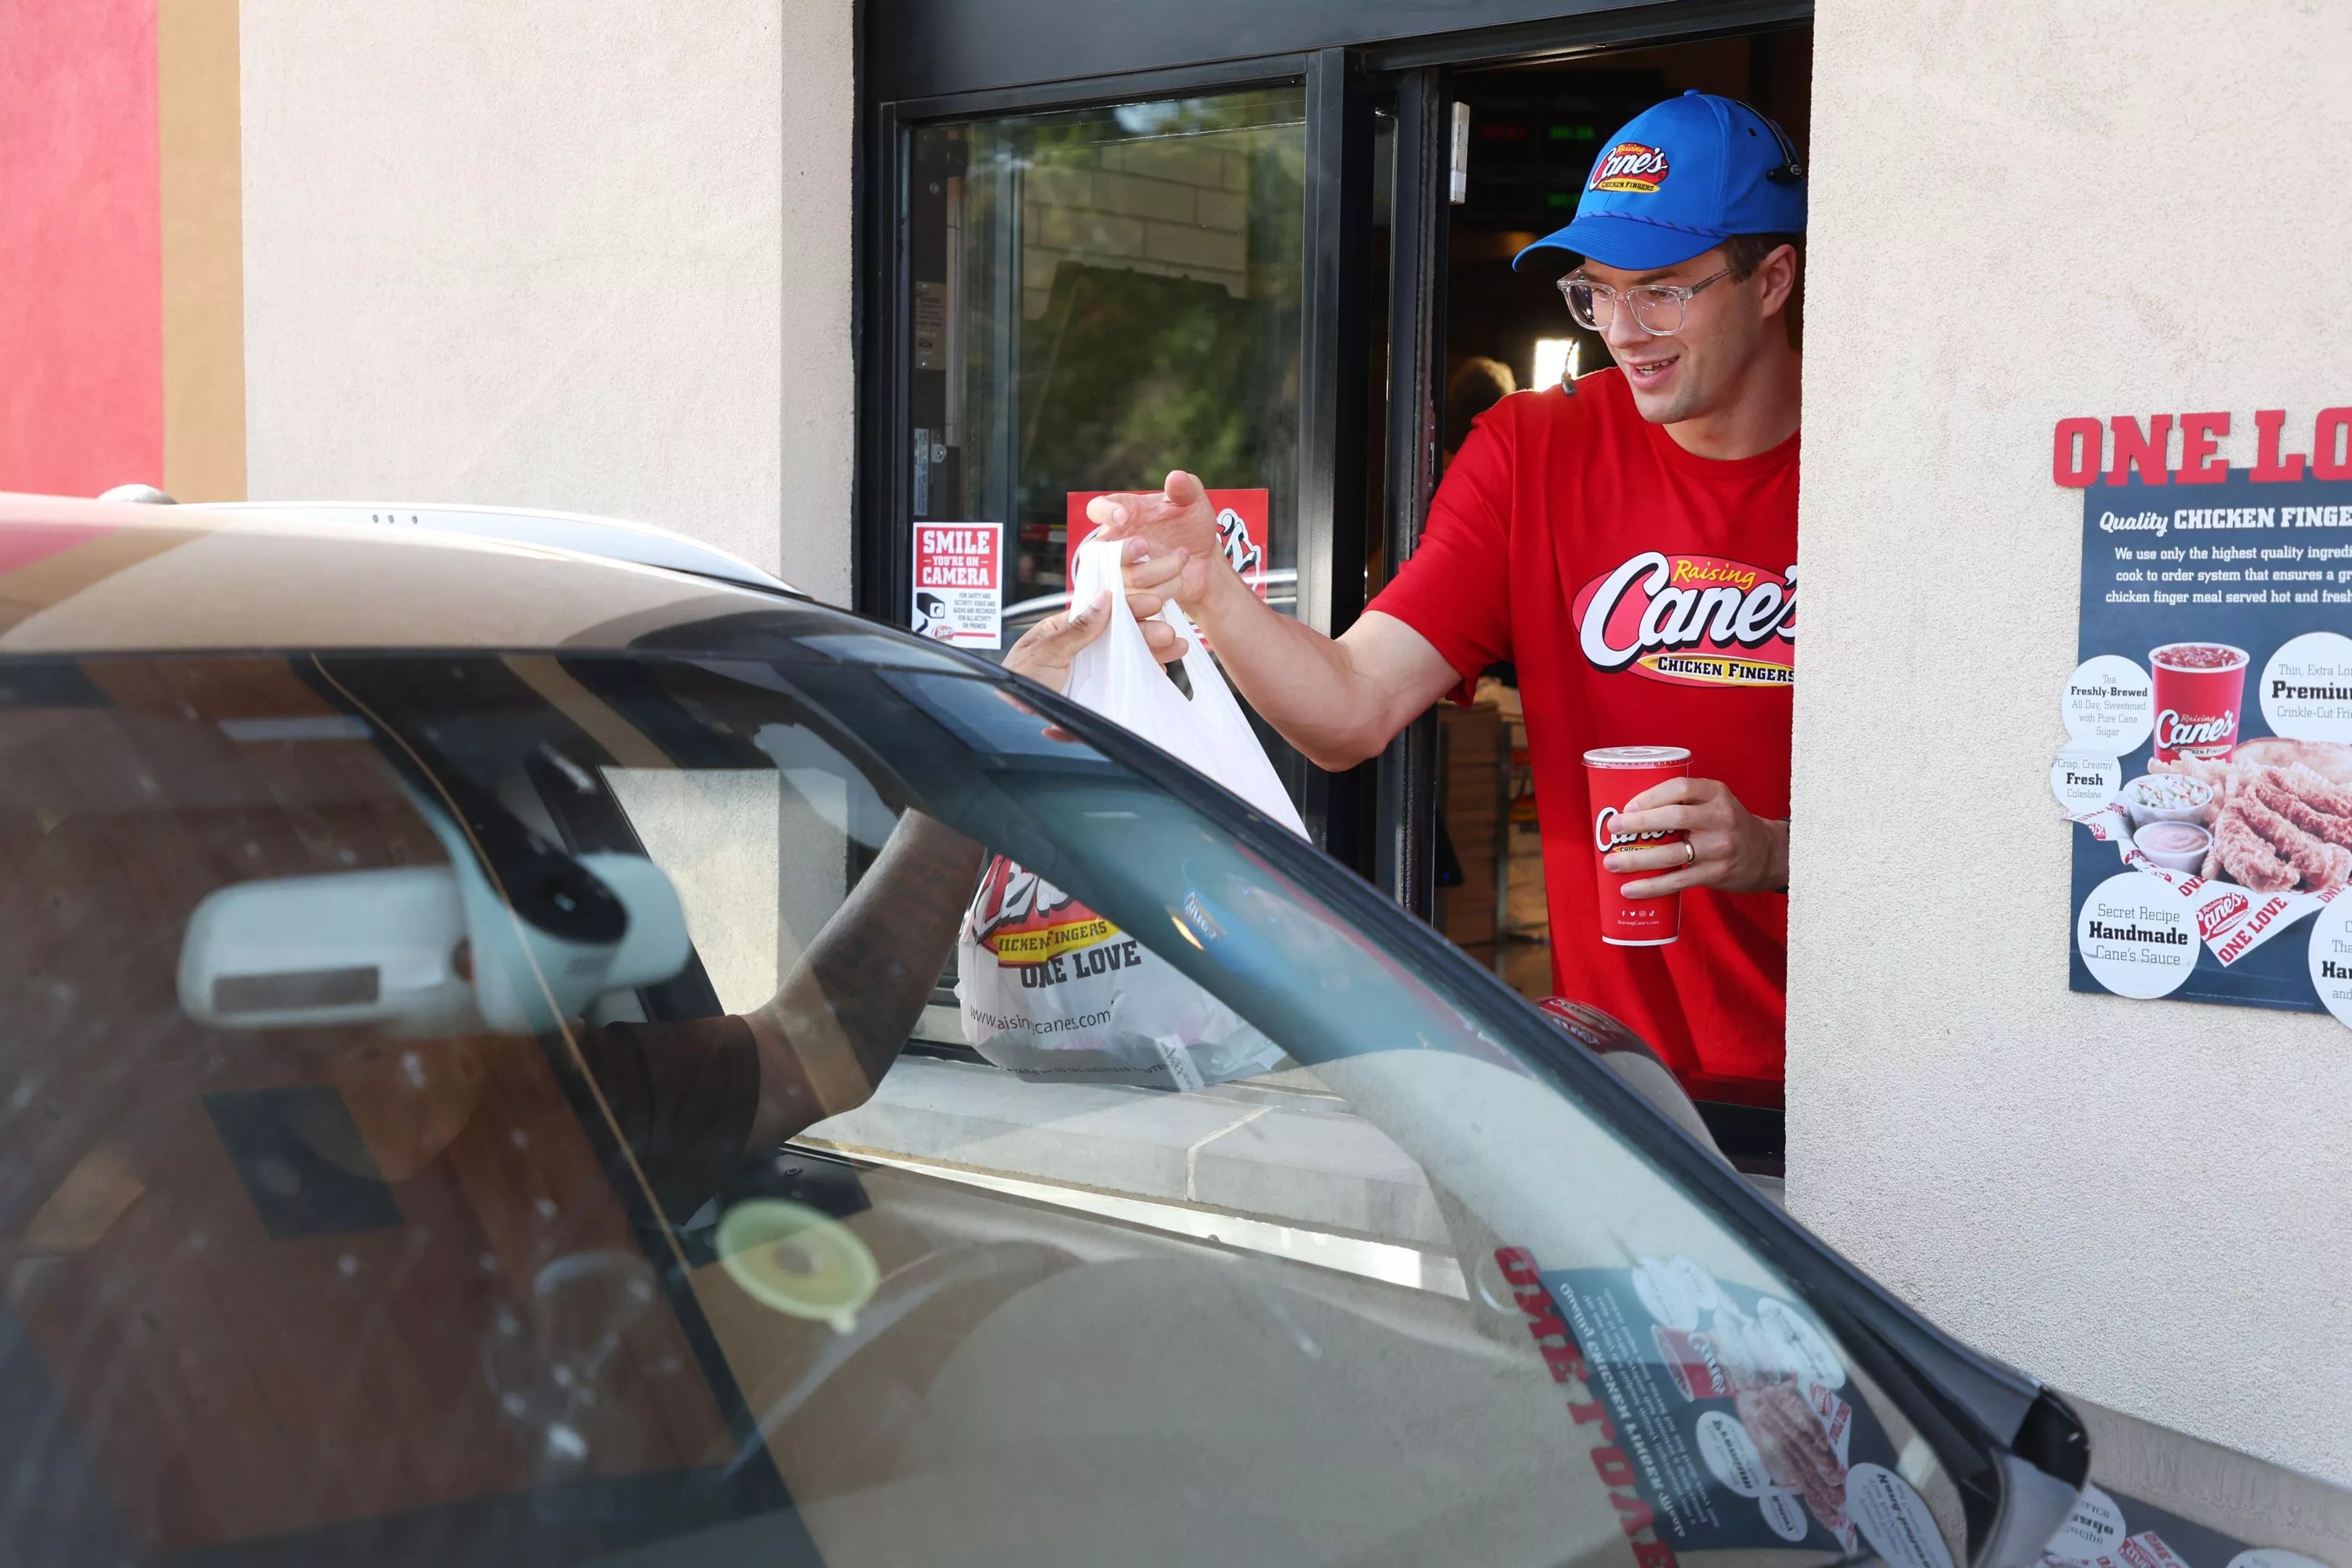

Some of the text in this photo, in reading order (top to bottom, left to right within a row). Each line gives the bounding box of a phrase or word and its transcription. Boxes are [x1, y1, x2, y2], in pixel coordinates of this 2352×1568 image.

[1617, 144, 1645, 154] Raising
[1589, 147, 1668, 190] Cane's
[1625, 181, 1654, 191] FINGERS
[2053, 408, 2352, 488] ONE LO
[2099, 505, 2352, 537] Quality CHICKEN FINGE
[923, 530, 990, 555] SMILE
[933, 555, 979, 567] YOU'RE ON
[2115, 544, 2352, 563] We use only the highest quality ingredi
[923, 567, 989, 586] CAMERA
[1673, 560, 1756, 589] Raising
[2115, 569, 2144, 581] cook
[2147, 570, 2158, 581] to
[2161, 568, 2194, 581] order
[2197, 570, 2242, 584] system
[2245, 568, 2269, 581] that
[2272, 570, 2323, 581] ensures
[2326, 571, 2335, 581] a
[2105, 591, 2150, 603] chicken
[2153, 590, 2189, 605] finger
[2192, 590, 2222, 603] meal
[2226, 589, 2267, 603] served
[2270, 590, 2291, 603] hot
[2295, 589, 2318, 603] and
[1657, 656, 1723, 676] CHICKEN
[2279, 663, 2352, 677] Thin, Extra Lo
[2102, 674, 2116, 684] Tea
[2070, 686, 2148, 699] Freshly-Brewed
[2272, 679, 2352, 699] Premiu
[2071, 700, 2147, 711] All Day, Sweetened
[2277, 706, 2333, 718] Crinkle-Cut
[2078, 714, 2138, 723] with Pure Cane
[2181, 714, 2216, 724] Raising
[2096, 727, 2120, 738] Sugar
[2156, 709, 2236, 749] Cane's
[2058, 759, 2113, 771] Crisp, Creamy
[2066, 772, 2104, 785] Fresh
[2067, 788, 2102, 799] Coleslaw
[2098, 903, 2180, 923] Secret Recipe
[1048, 920, 1107, 945] FINGERS
[2088, 920, 2188, 945] Handmade
[2218, 897, 2289, 963] ONE LOVE
[1072, 940, 1142, 979] LOVE
[2096, 945, 2181, 965] Cane's Sauce
